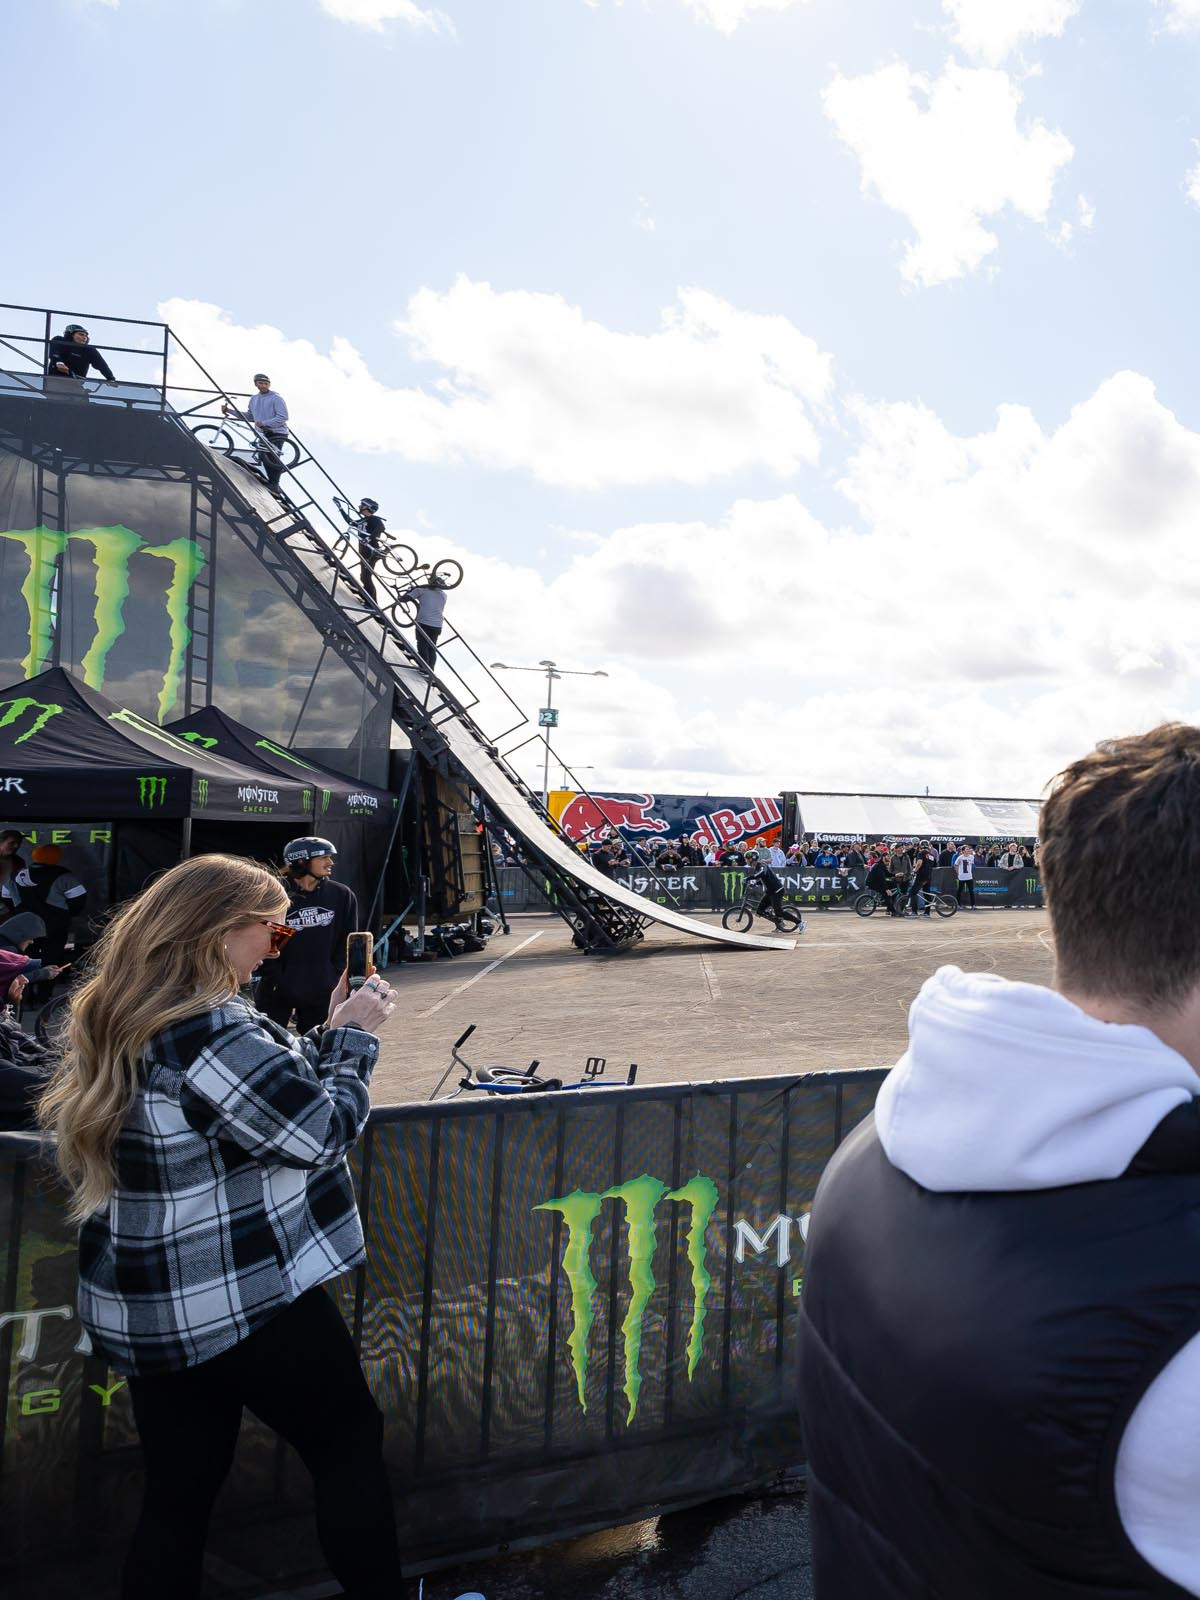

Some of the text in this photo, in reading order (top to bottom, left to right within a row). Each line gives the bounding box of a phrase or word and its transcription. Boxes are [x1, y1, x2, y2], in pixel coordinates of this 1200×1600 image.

[238, 785, 279, 804] MONSTER
[347, 792, 378, 809] MONSTER
[243, 805, 272, 813] ENERGY
[709, 797, 783, 842] Bull
[814, 832, 867, 842] Kawasaki
[616, 874, 700, 894] NSTER
[782, 894, 843, 902] NERGY
[299, 909, 318, 917] VANS
[302, 916, 315, 924] THE
